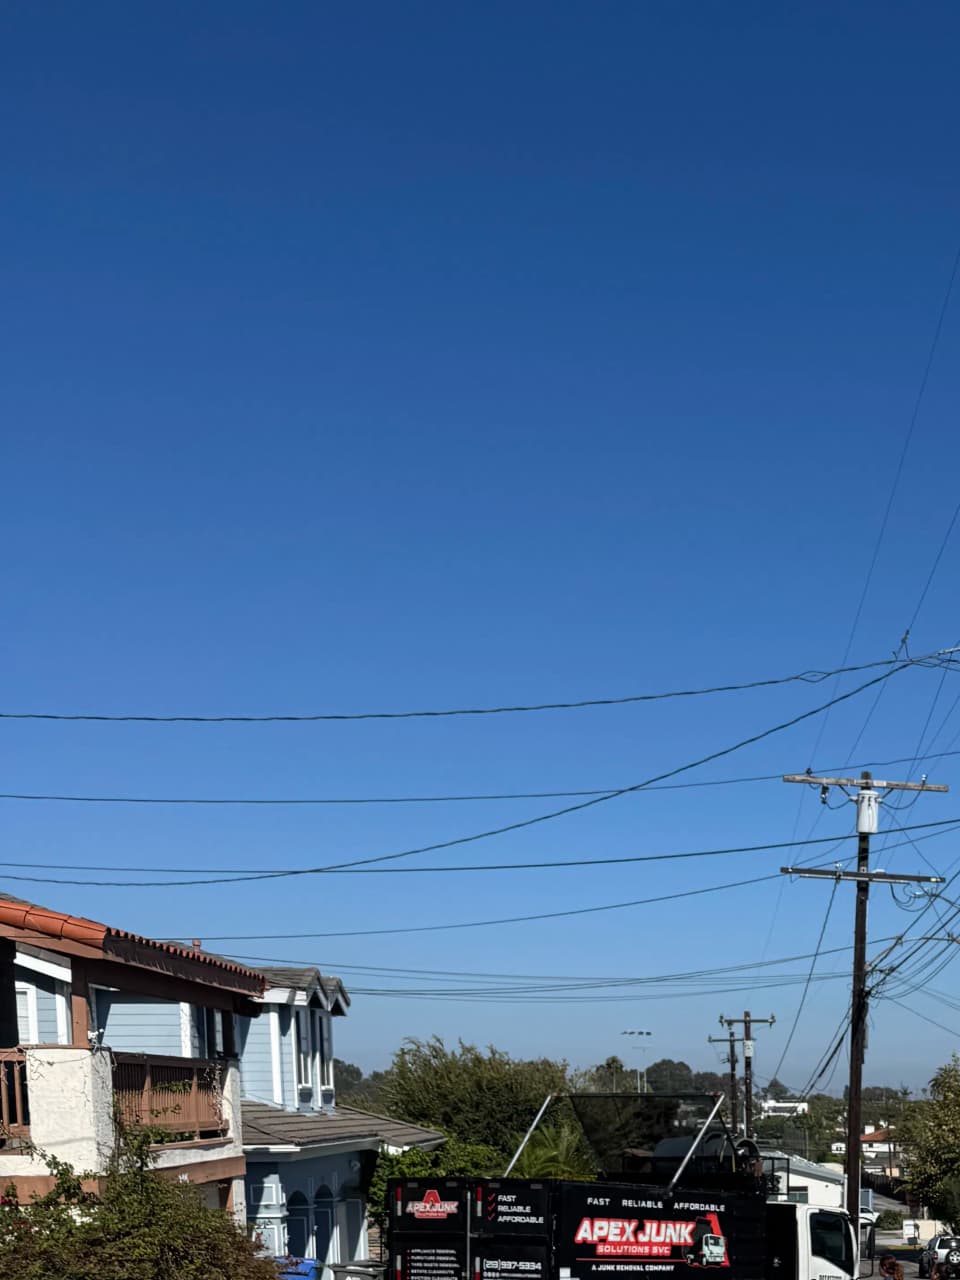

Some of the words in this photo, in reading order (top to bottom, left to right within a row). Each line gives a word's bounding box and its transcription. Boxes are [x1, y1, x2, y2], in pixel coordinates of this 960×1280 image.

[498, 1195, 516, 1203] FAST
[498, 1204, 531, 1213] RELIABLE
[587, 1197, 611, 1205] FAST
[622, 1199, 664, 1209] RELIABLE
[673, 1202, 726, 1212] AFFORDABLE
[497, 1215, 544, 1224] AFFORDABLE
[576, 1219, 637, 1243] APEX
[636, 1221, 696, 1244] JUNK
[598, 1244, 649, 1254] SOLUTIONS
[652, 1246, 671, 1255] SVC
